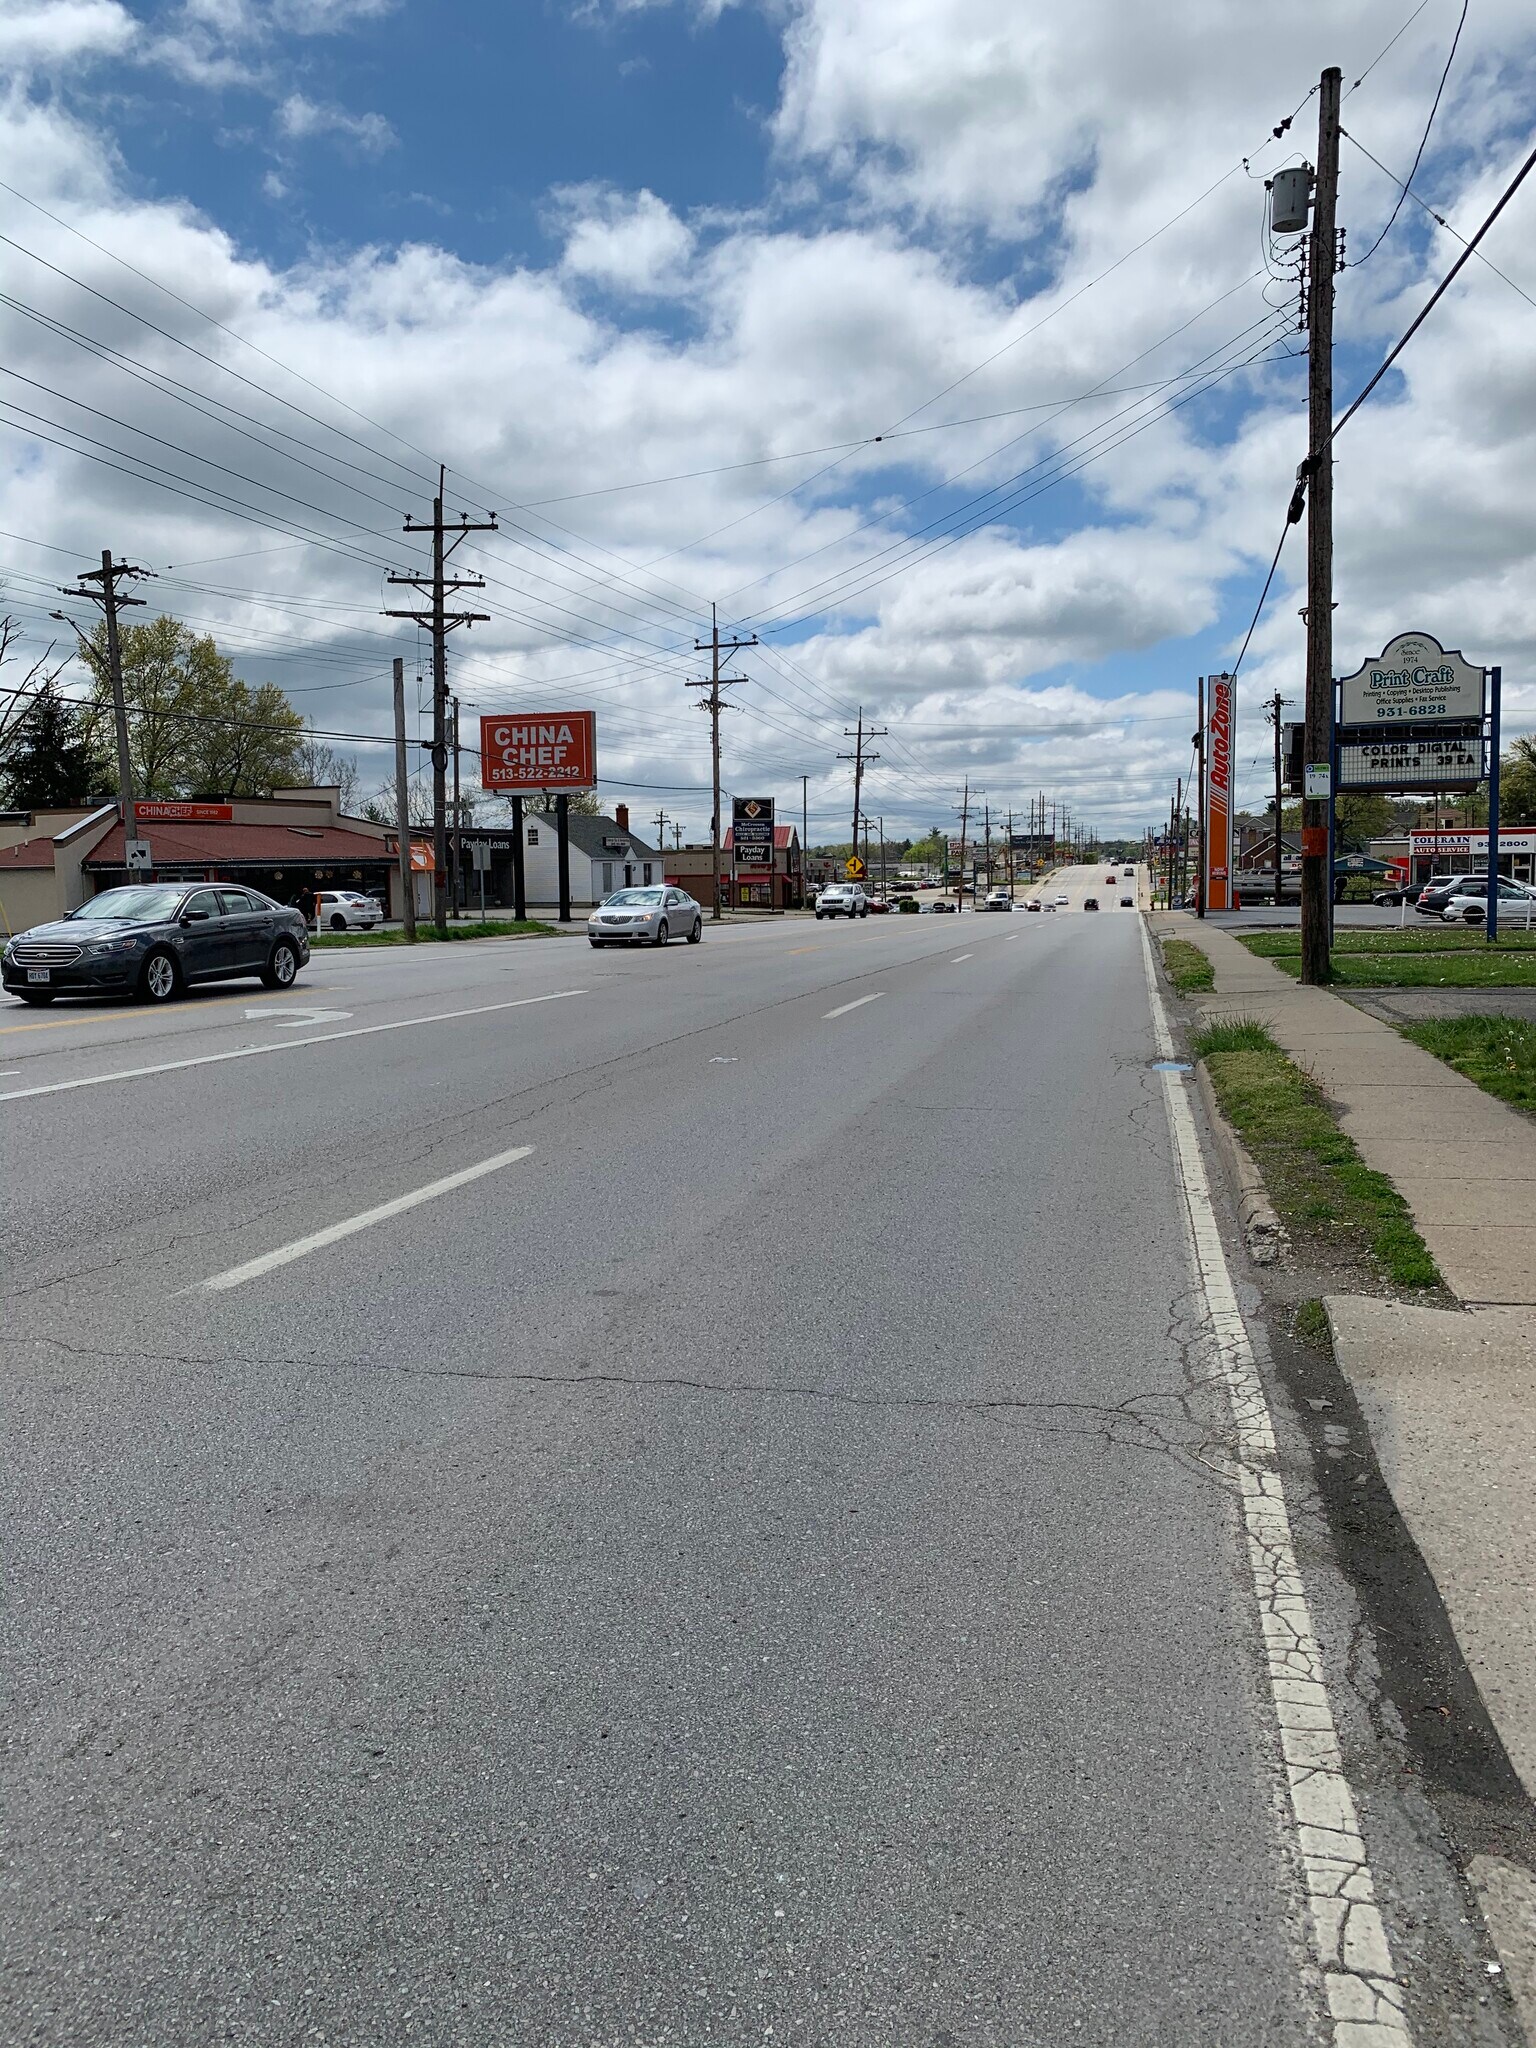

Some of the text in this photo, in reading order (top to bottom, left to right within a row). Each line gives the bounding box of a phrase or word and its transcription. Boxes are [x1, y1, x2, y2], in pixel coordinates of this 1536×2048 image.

[1370, 665, 1454, 689] Print Craft
[1387, 689, 1407, 697] Copying
[1434, 685, 1461, 693] Publishing
[1377, 704, 1446, 717] 931-6828
[494, 725, 574, 746] CHINA
[1211, 682, 1231, 791] AutoZone
[502, 746, 567, 766] CHEF
[1362, 742, 1467, 756] COLOR DIGITAL
[1371, 754, 1475, 768] PRINTS 39 EA
[492, 766, 579, 780] 513-522-2212
[139, 806, 169, 816] CHINA
[461, 837, 510, 851] Payday Loans
[1414, 836, 1470, 844] COLERAIN
[740, 846, 765, 854] Payday
